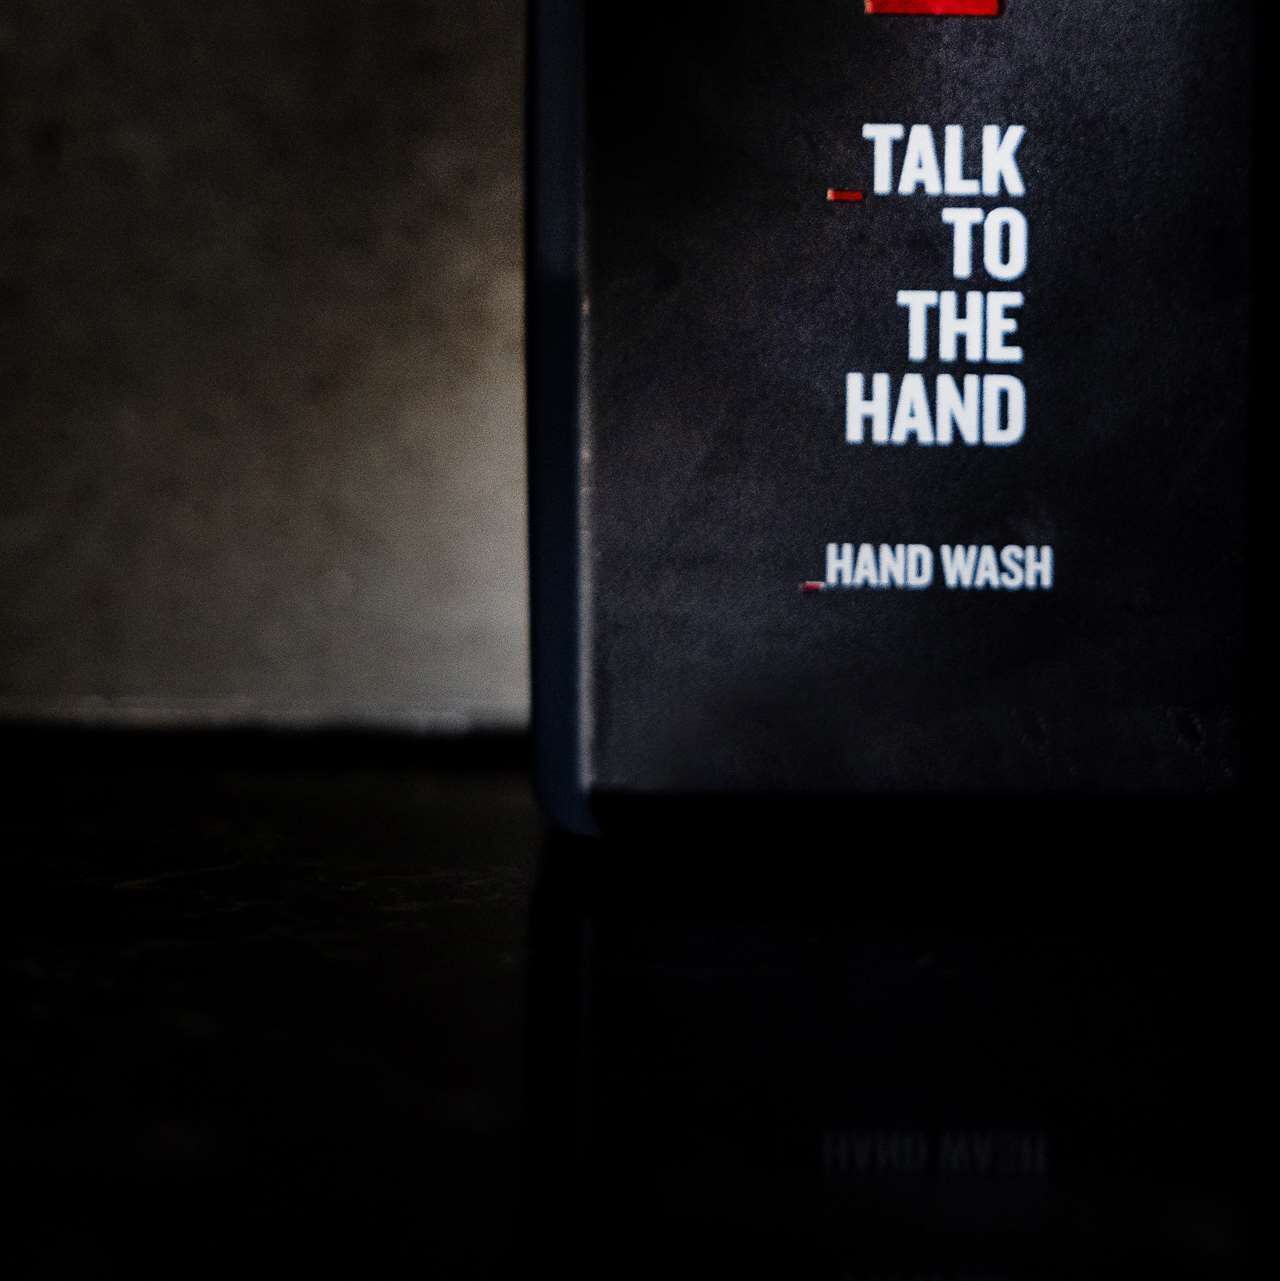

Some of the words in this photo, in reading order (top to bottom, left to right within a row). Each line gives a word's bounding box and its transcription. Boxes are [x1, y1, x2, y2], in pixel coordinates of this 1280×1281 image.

[862, 123, 1027, 196] TALK
[941, 206, 1028, 281] TO
[896, 290, 1024, 363] THE
[845, 372, 1028, 447] HAND
[825, 542, 933, 589] HAND
[939, 543, 1054, 590] WASH
